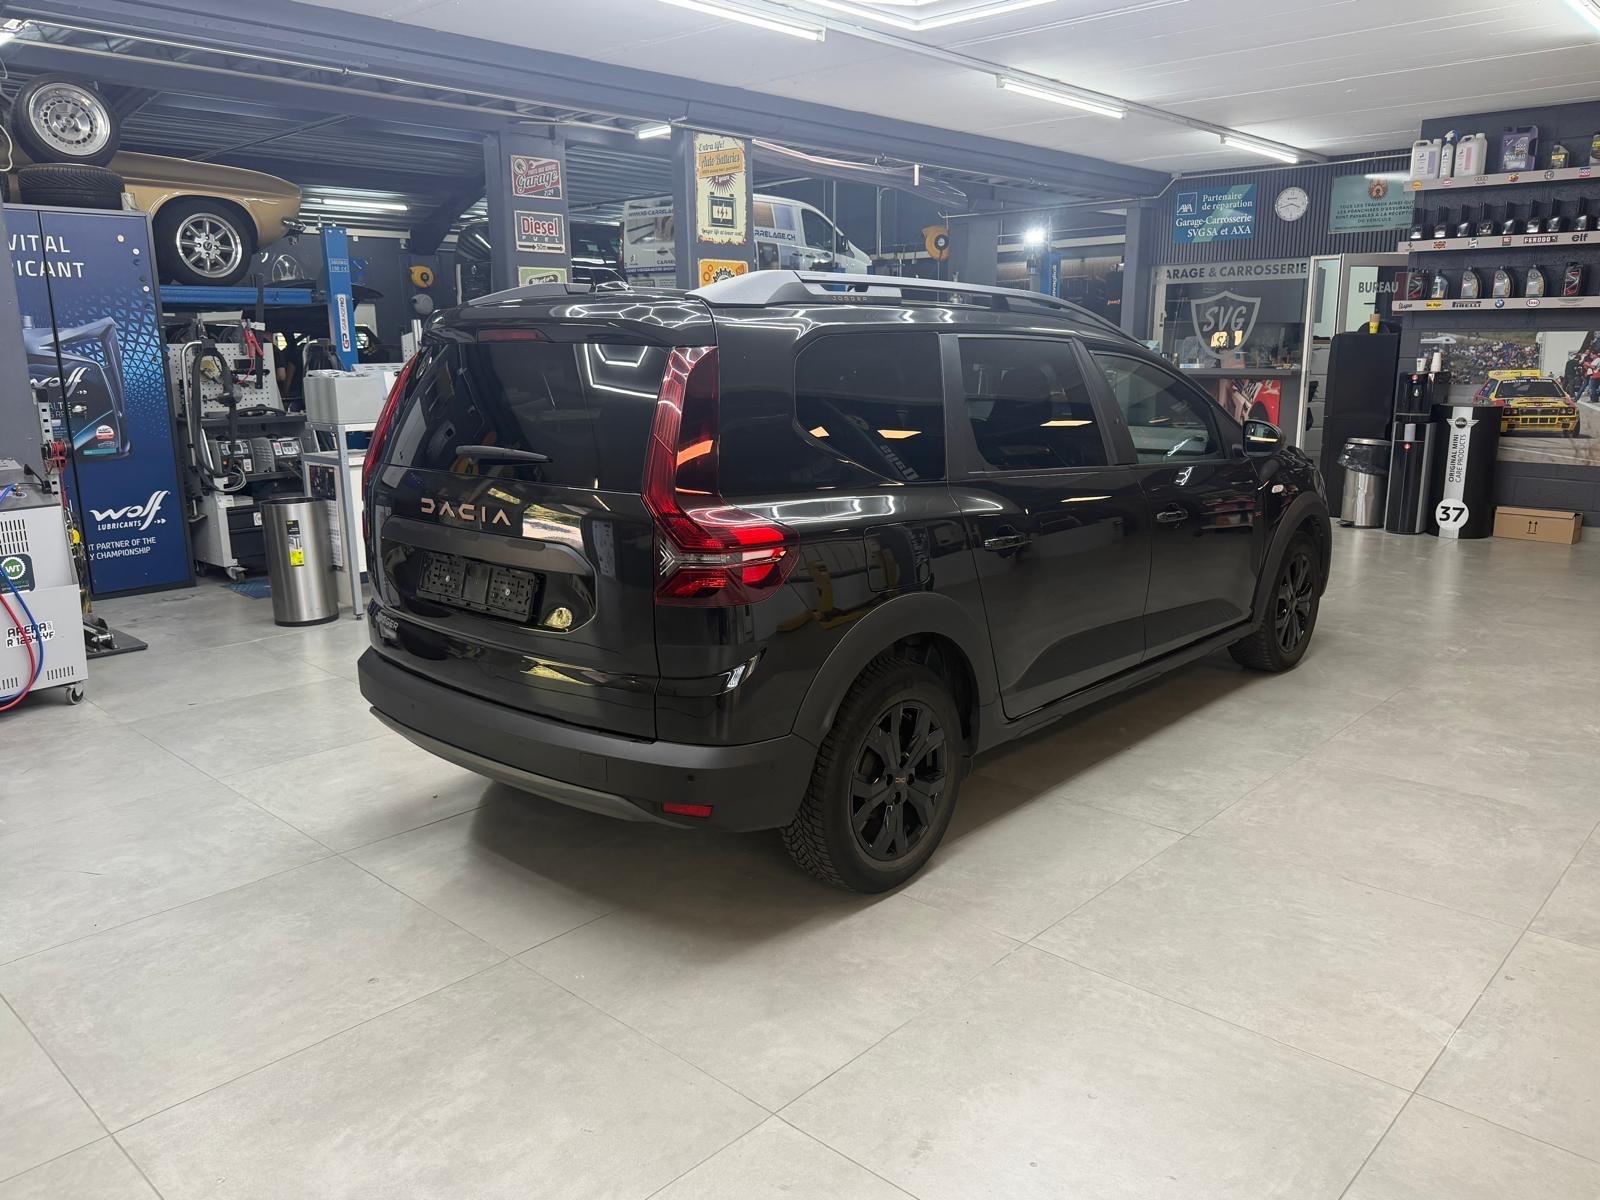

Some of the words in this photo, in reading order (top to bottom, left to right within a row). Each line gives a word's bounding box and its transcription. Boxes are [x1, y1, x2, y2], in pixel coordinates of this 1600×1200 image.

[1202, 192, 1242, 202] Partenaire
[1177, 204, 1192, 213] AXA
[1202, 202, 1211, 210] de
[1212, 200, 1252, 211] réparation
[521, 216, 559, 236] Diesel
[1176, 213, 1252, 228] Garage-Carrosserie
[754, 230, 795, 240] RRELAGE.CH
[1187, 228, 1206, 238] SVG
[1206, 228, 1218, 236] SA
[1230, 226, 1251, 235] AXA
[1571, 234, 1588, 242] elf
[8, 234, 70, 253] VITAL
[14, 260, 84, 278] ICANT
[1166, 268, 1205, 280] ARAGE
[1209, 266, 1217, 278] &
[1220, 263, 1307, 277] CARROSSERIE
[1358, 282, 1399, 293] BUREAU
[1202, 305, 1247, 332] SVG
[1458, 434, 1467, 465] PRODUCTS
[1448, 450, 1457, 483] ORIGINAL
[421, 497, 511, 526] DACIA
[1439, 506, 1465, 522] 37
[98, 520, 142, 530] LUBRICANTS
[96, 540, 130, 550] PARTNER
[96, 546, 151, 560] CHAMPIONSHIP
[5, 564, 21, 574] WT
